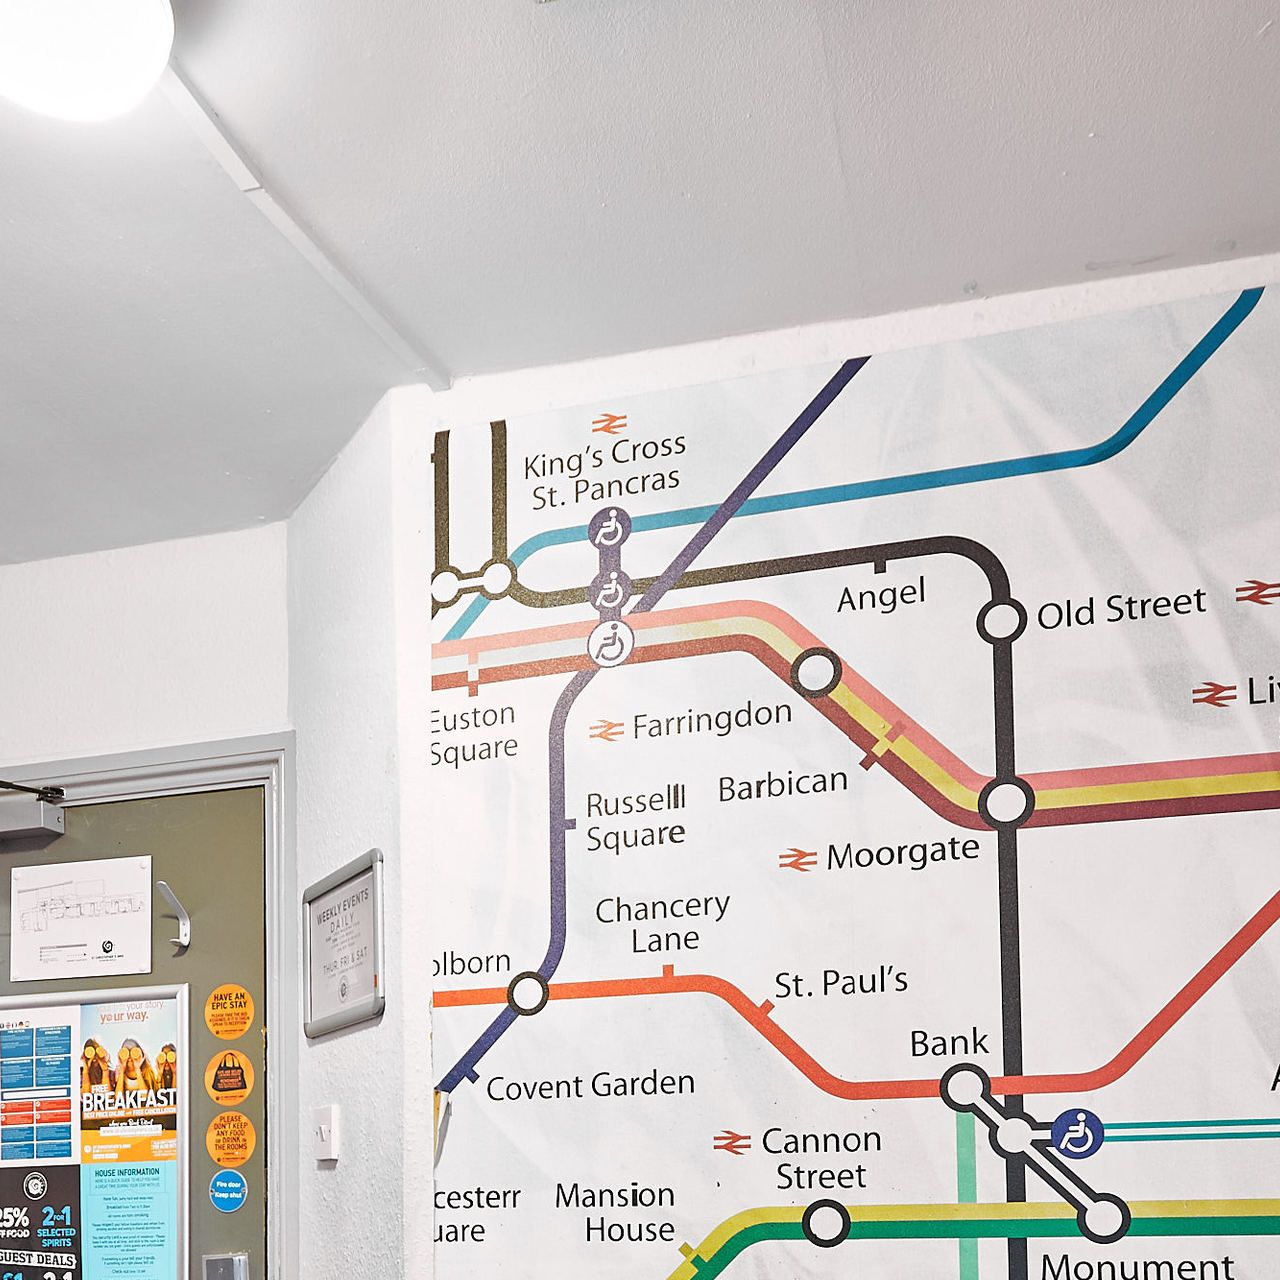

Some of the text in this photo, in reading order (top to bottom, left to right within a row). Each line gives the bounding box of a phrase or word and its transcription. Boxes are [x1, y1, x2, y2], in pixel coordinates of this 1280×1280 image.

[525, 435, 686, 480] King's Cross
[532, 470, 680, 511] St. Pancras
[836, 575, 925, 614] Angel
[1037, 588, 1207, 630] Old Street
[634, 700, 792, 740] Farringdon
[430, 739, 518, 770] Square
[719, 770, 848, 802] Barbican
[587, 825, 686, 856] Square
[827, 837, 980, 871] Moorgate
[317, 888, 369, 925] WEEKLY EVENTS
[596, 895, 731, 924] Chancery
[330, 912, 354, 933] DAILY
[632, 928, 700, 953] Lane
[775, 965, 908, 999] St. Paul's
[212, 1000, 247, 1010] EPIC STAY
[214, 992, 244, 1001] HAVE AN
[127, 1011, 149, 1022] way.
[911, 1026, 990, 1057] Bank
[486, 1068, 695, 1101] Covent Garden
[83, 1088, 176, 1112] BREAKFAST
[214, 1122, 231, 1130] DON'T
[762, 1127, 881, 1155] Cannon
[95, 1167, 160, 1177] HOUSE INFORMATION
[777, 1162, 867, 1190] Street
[555, 1182, 675, 1209] Mansion
[6, 1229, 30, 1238] FOOD
[37, 1228, 76, 1237] SELECTED
[42, 1238, 72, 1248] SPIRITS
[586, 1216, 675, 1242] House
[37, 1254, 74, 1267] DEALS
